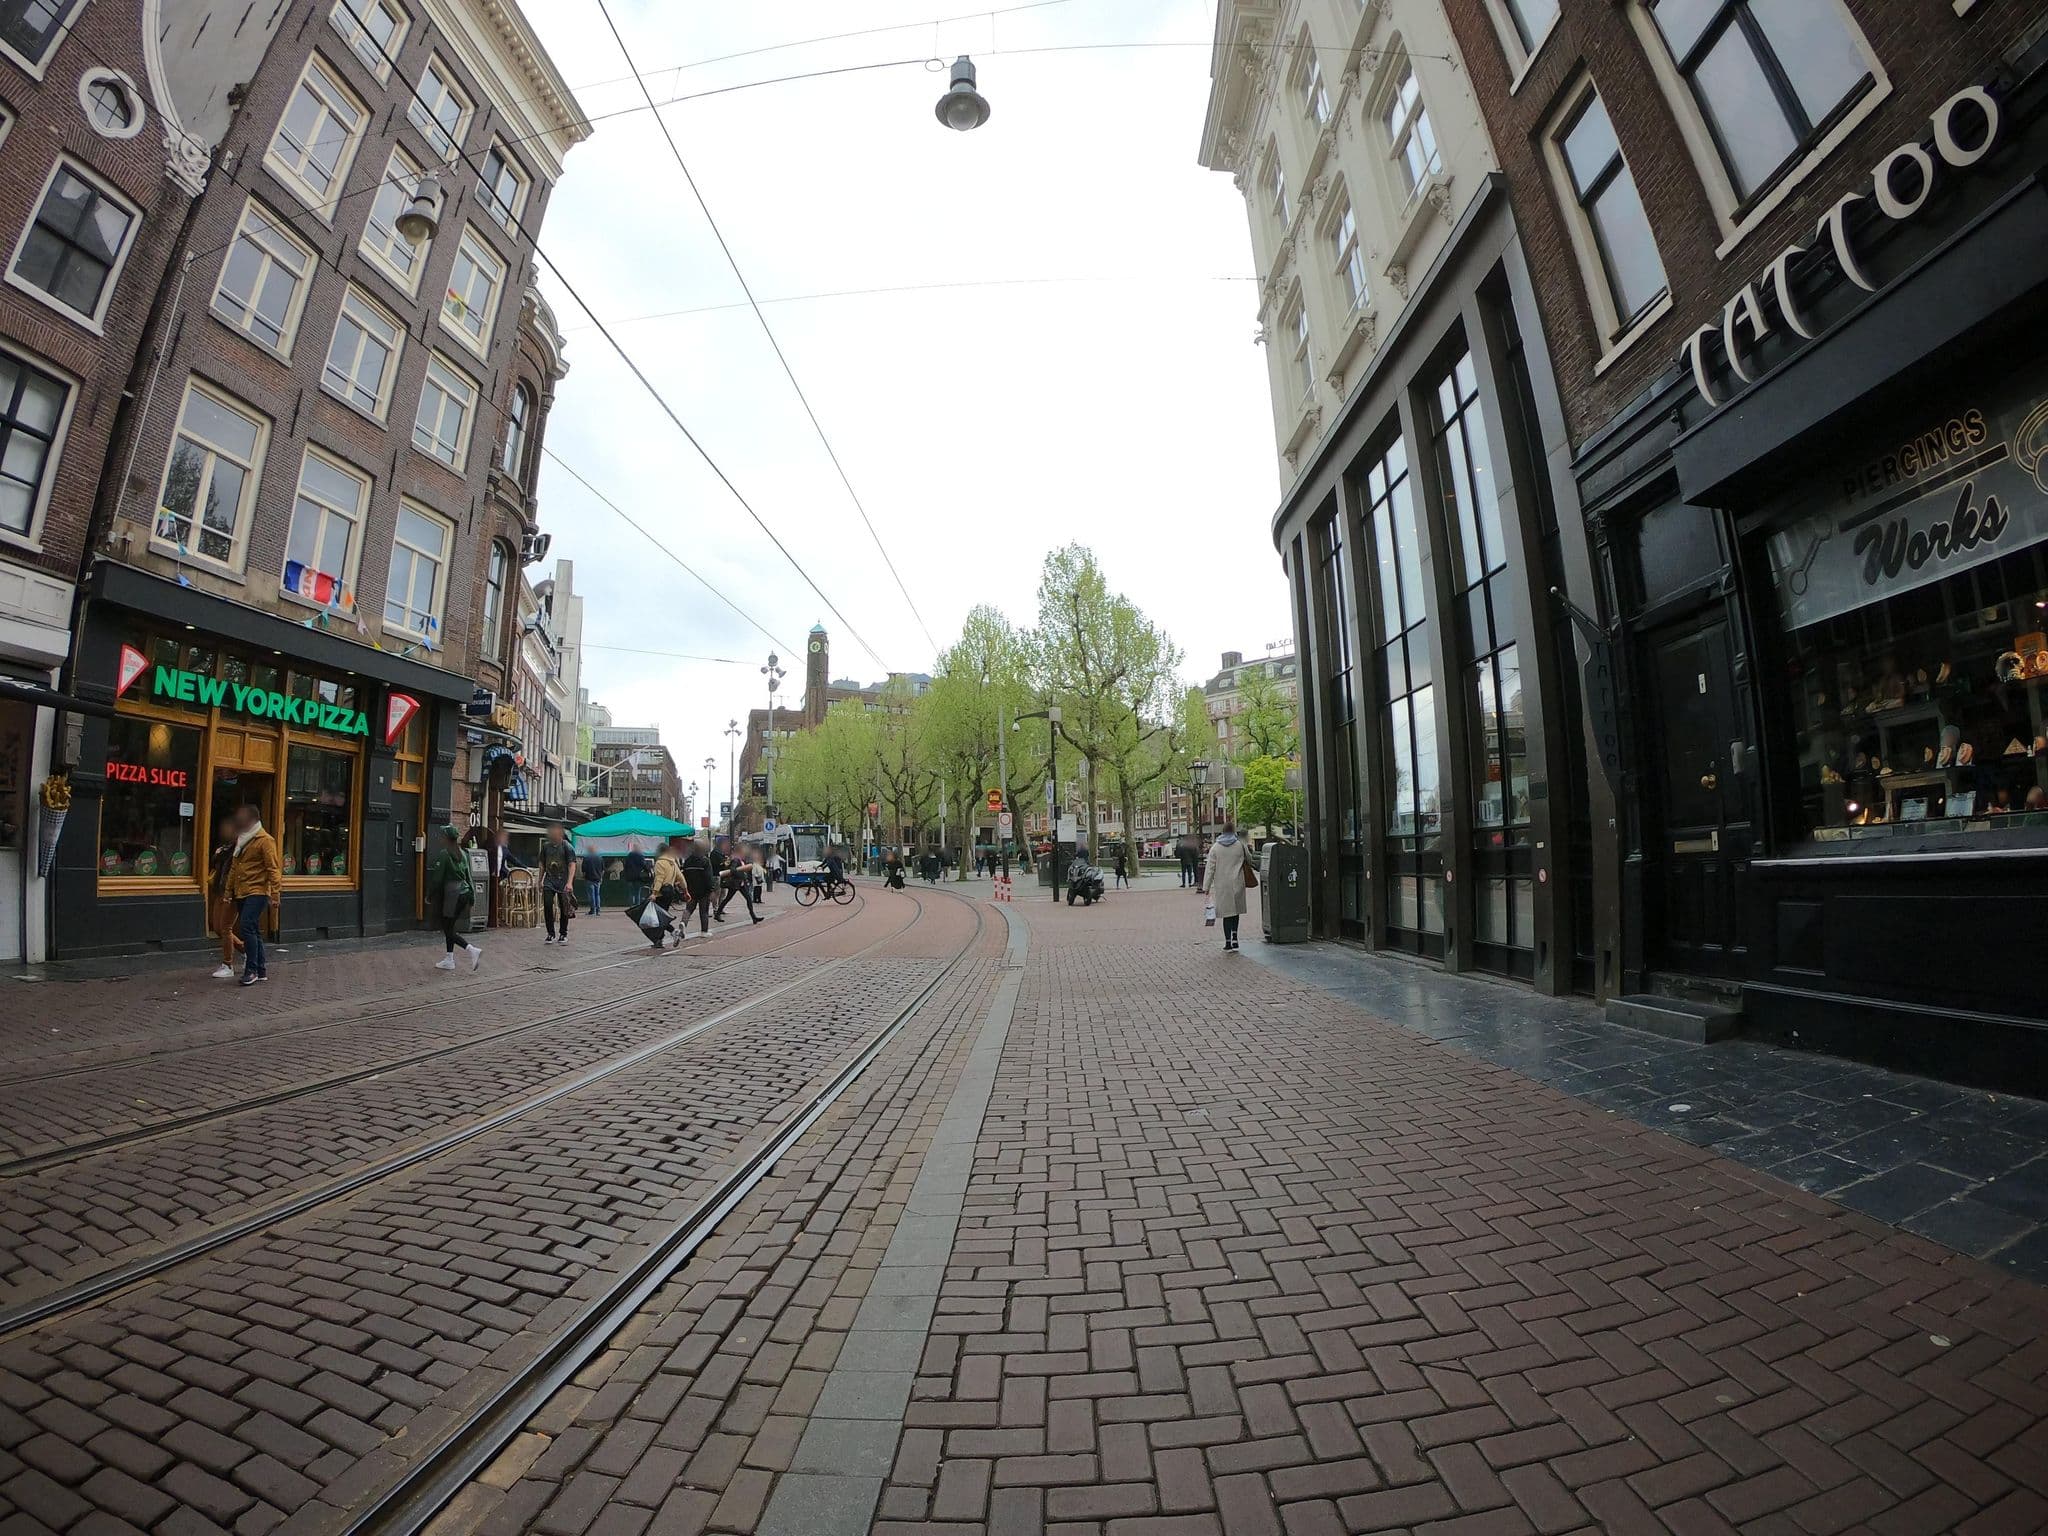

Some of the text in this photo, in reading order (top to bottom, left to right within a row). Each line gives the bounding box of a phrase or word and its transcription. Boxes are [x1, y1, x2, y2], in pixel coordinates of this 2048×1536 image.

[1680, 84, 2000, 407] TATTOO
[1844, 408, 1988, 501] PIERCINGS
[1853, 480, 2009, 586] Works
[154, 666, 227, 708] NEW
[231, 682, 302, 724] YORK
[303, 700, 369, 736] PIZZA
[106, 762, 187, 788] PIZZA SLICE
